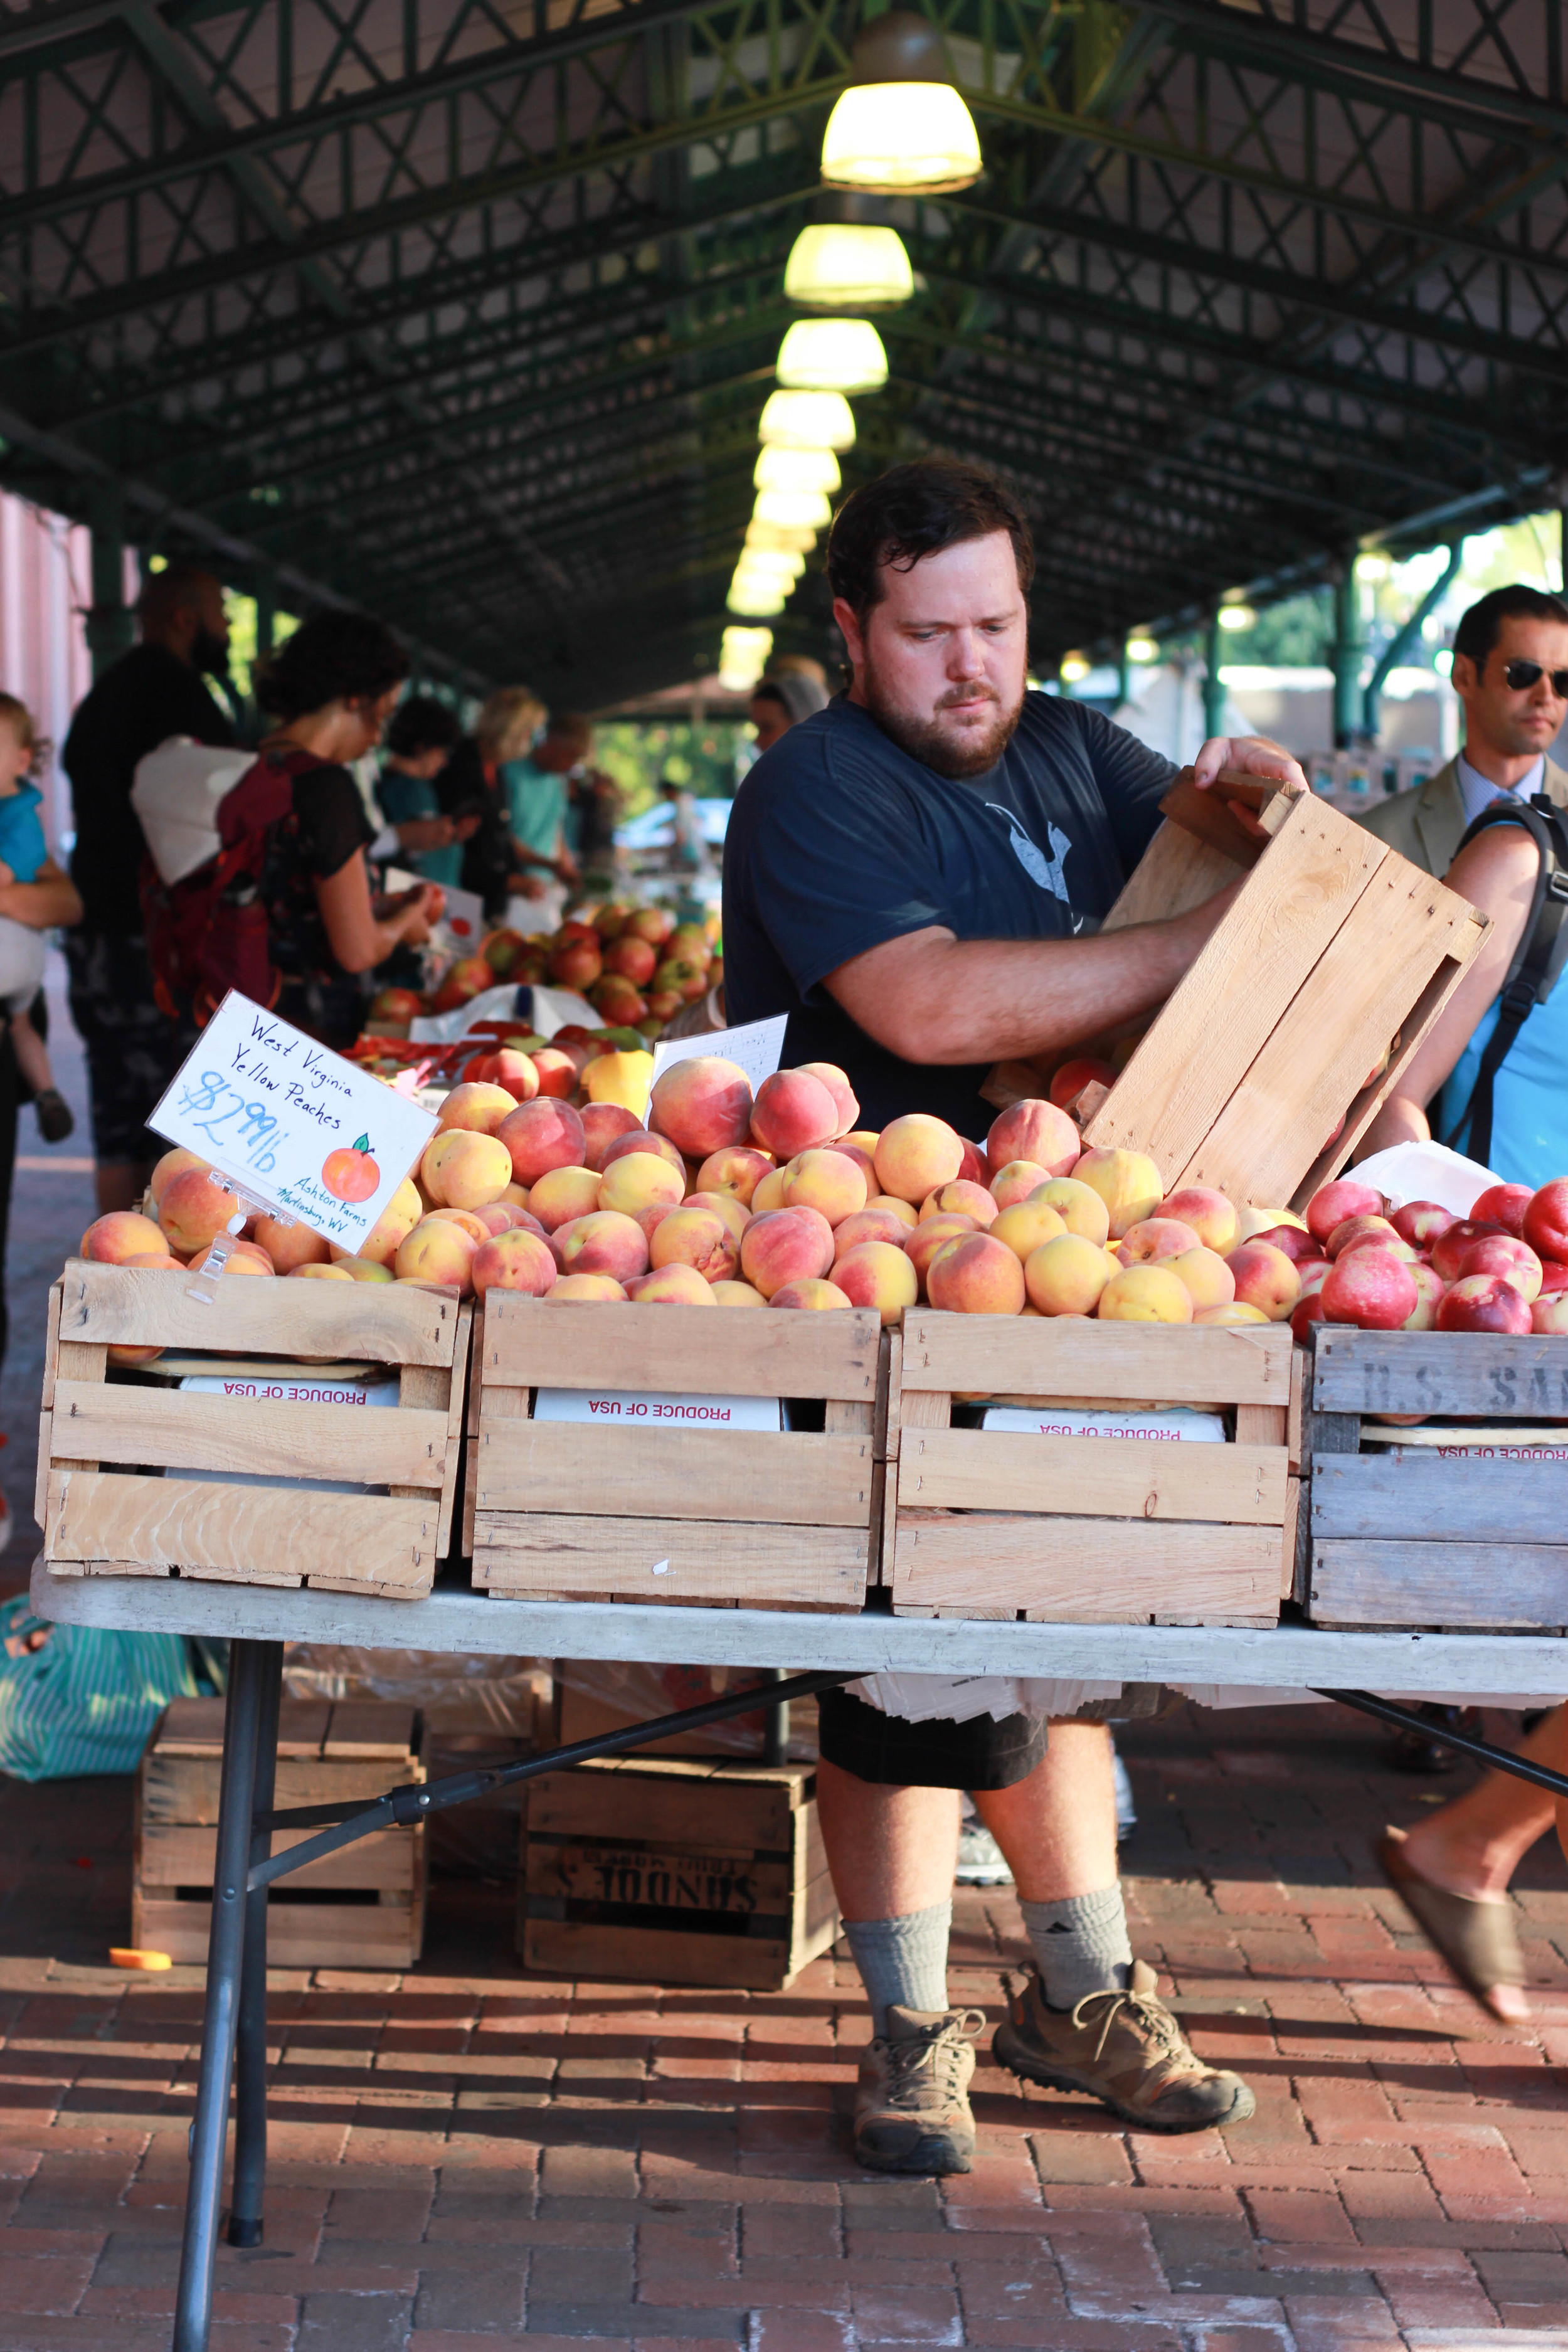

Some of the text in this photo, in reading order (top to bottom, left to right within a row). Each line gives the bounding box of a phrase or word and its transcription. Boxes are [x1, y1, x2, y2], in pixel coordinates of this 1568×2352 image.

[251, 1014, 352, 1097] West Virginia
[231, 1042, 341, 1130] Yellow Peaches
[294, 1177, 368, 1227] Ashton Farms
[328, 1217, 349, 1232] WV
[223, 1382, 367, 1405] PRODUCE OF USA
[588, 1400, 731, 1421] PRODUCE OF USA
[1039, 1424, 1181, 1441] PRODUCE OF USA
[1436, 1446, 1568, 1460] RODUCE OF USA
